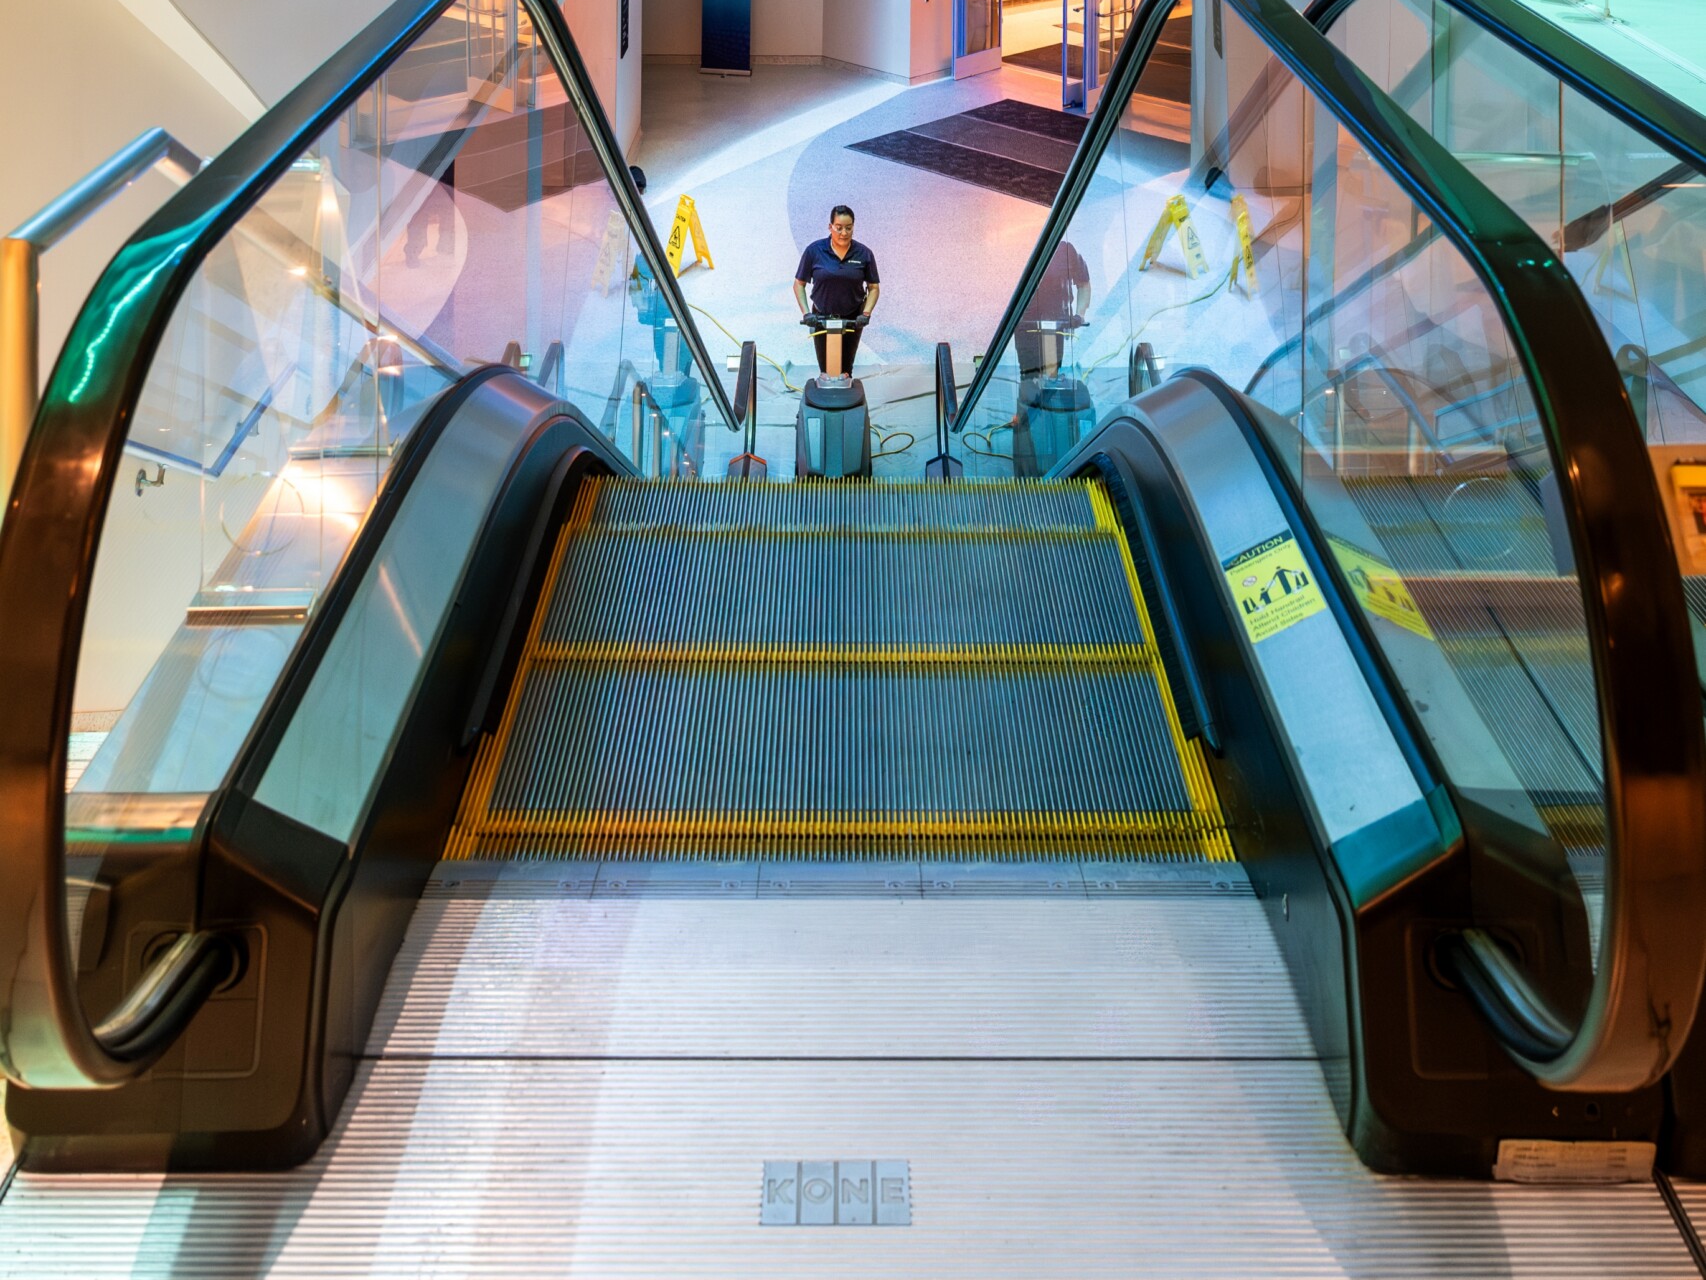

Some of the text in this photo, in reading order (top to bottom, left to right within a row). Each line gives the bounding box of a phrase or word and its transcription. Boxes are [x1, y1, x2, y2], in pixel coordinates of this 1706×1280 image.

[1230, 535, 1284, 566] CAUTION
[1249, 594, 1305, 625] Hold Handrail
[767, 1177, 905, 1205] KONE
